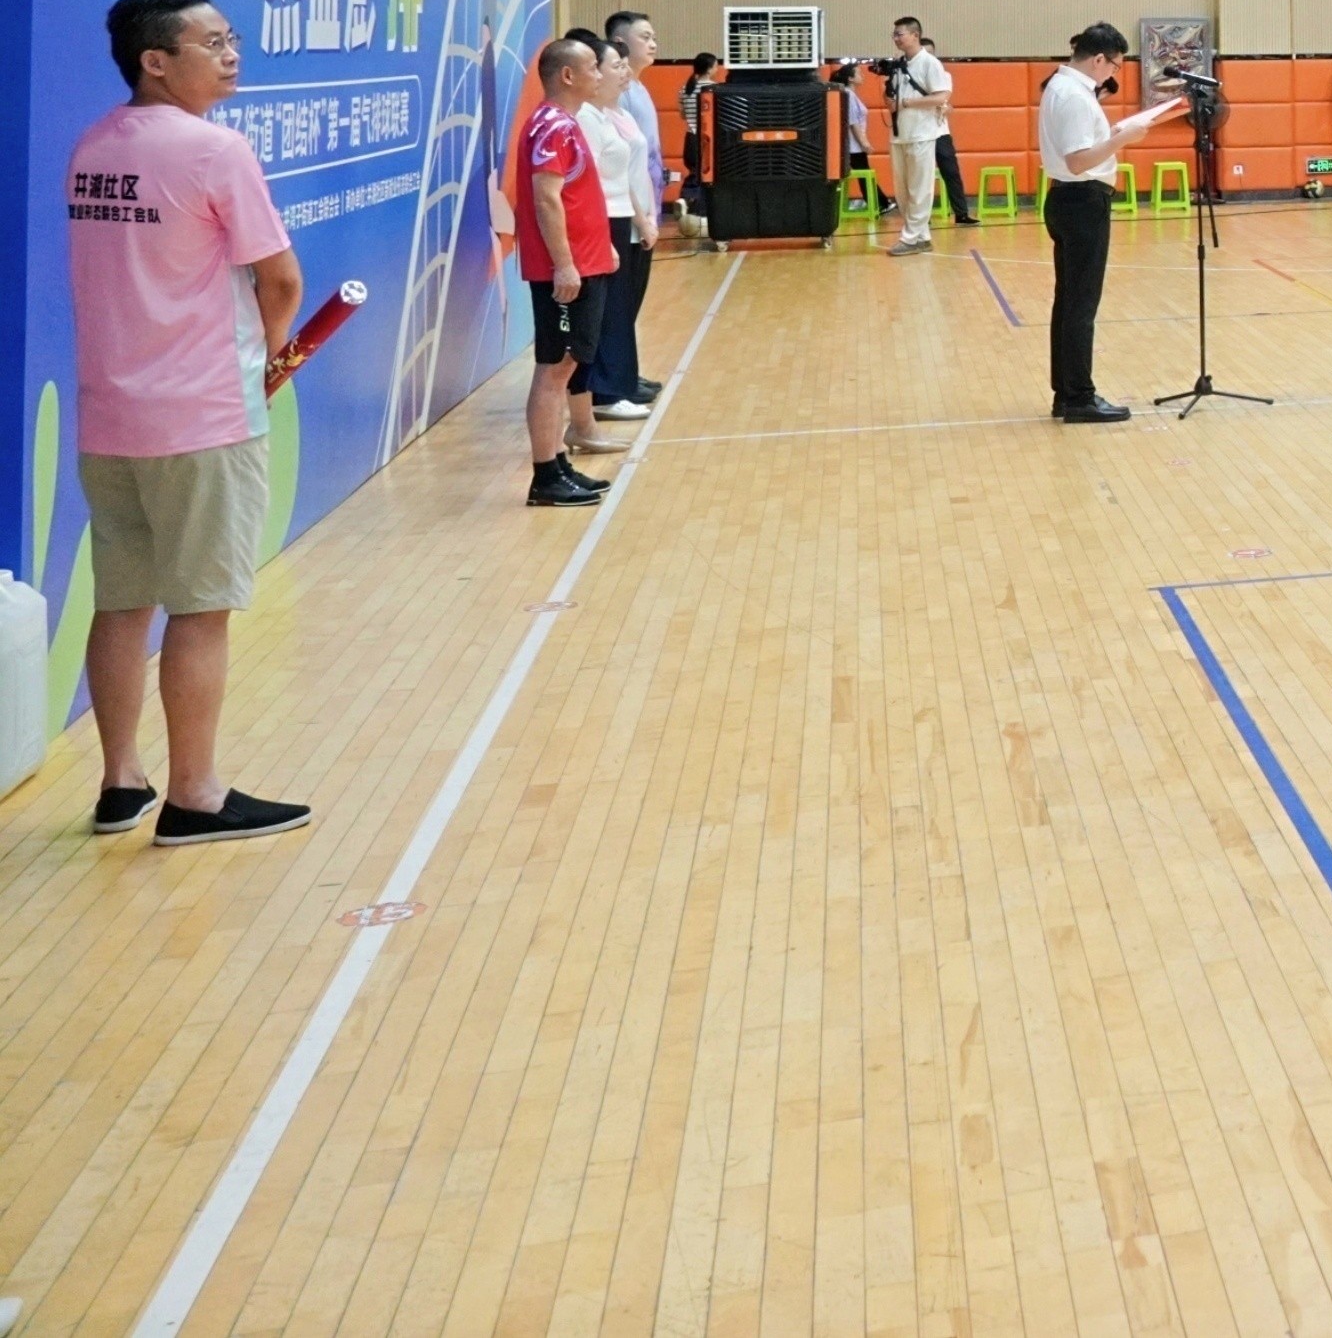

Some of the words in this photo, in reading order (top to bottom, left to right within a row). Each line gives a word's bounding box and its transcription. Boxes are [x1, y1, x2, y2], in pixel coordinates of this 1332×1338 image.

[205, 90, 410, 163] 街道“团结杯”第一届气排球联赛
[75, 173, 139, 201] 井湘社区
